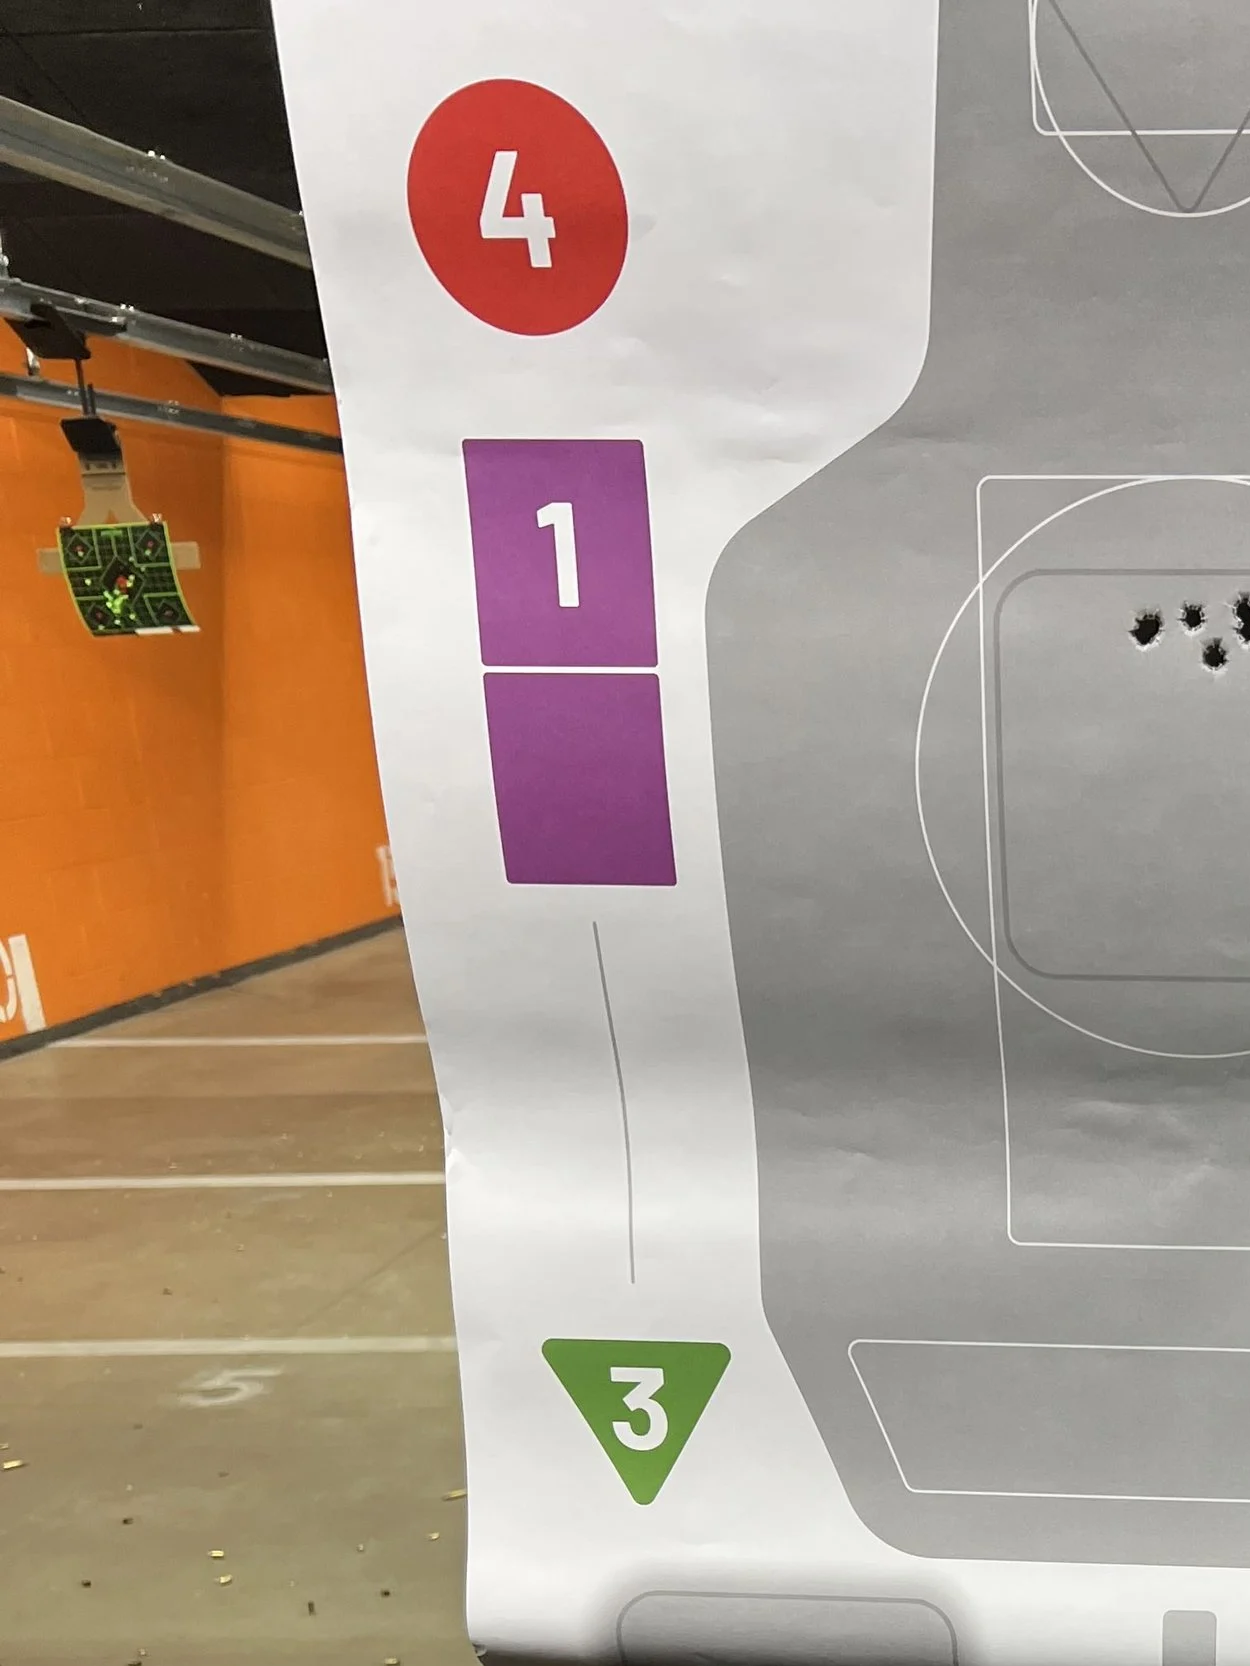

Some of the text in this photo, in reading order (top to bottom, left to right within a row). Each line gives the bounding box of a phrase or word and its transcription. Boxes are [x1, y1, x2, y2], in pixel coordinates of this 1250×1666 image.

[479, 150, 556, 268] 4
[536, 502, 580, 608] 1
[178, 1367, 285, 1408] 5
[610, 1366, 668, 1451] 3
